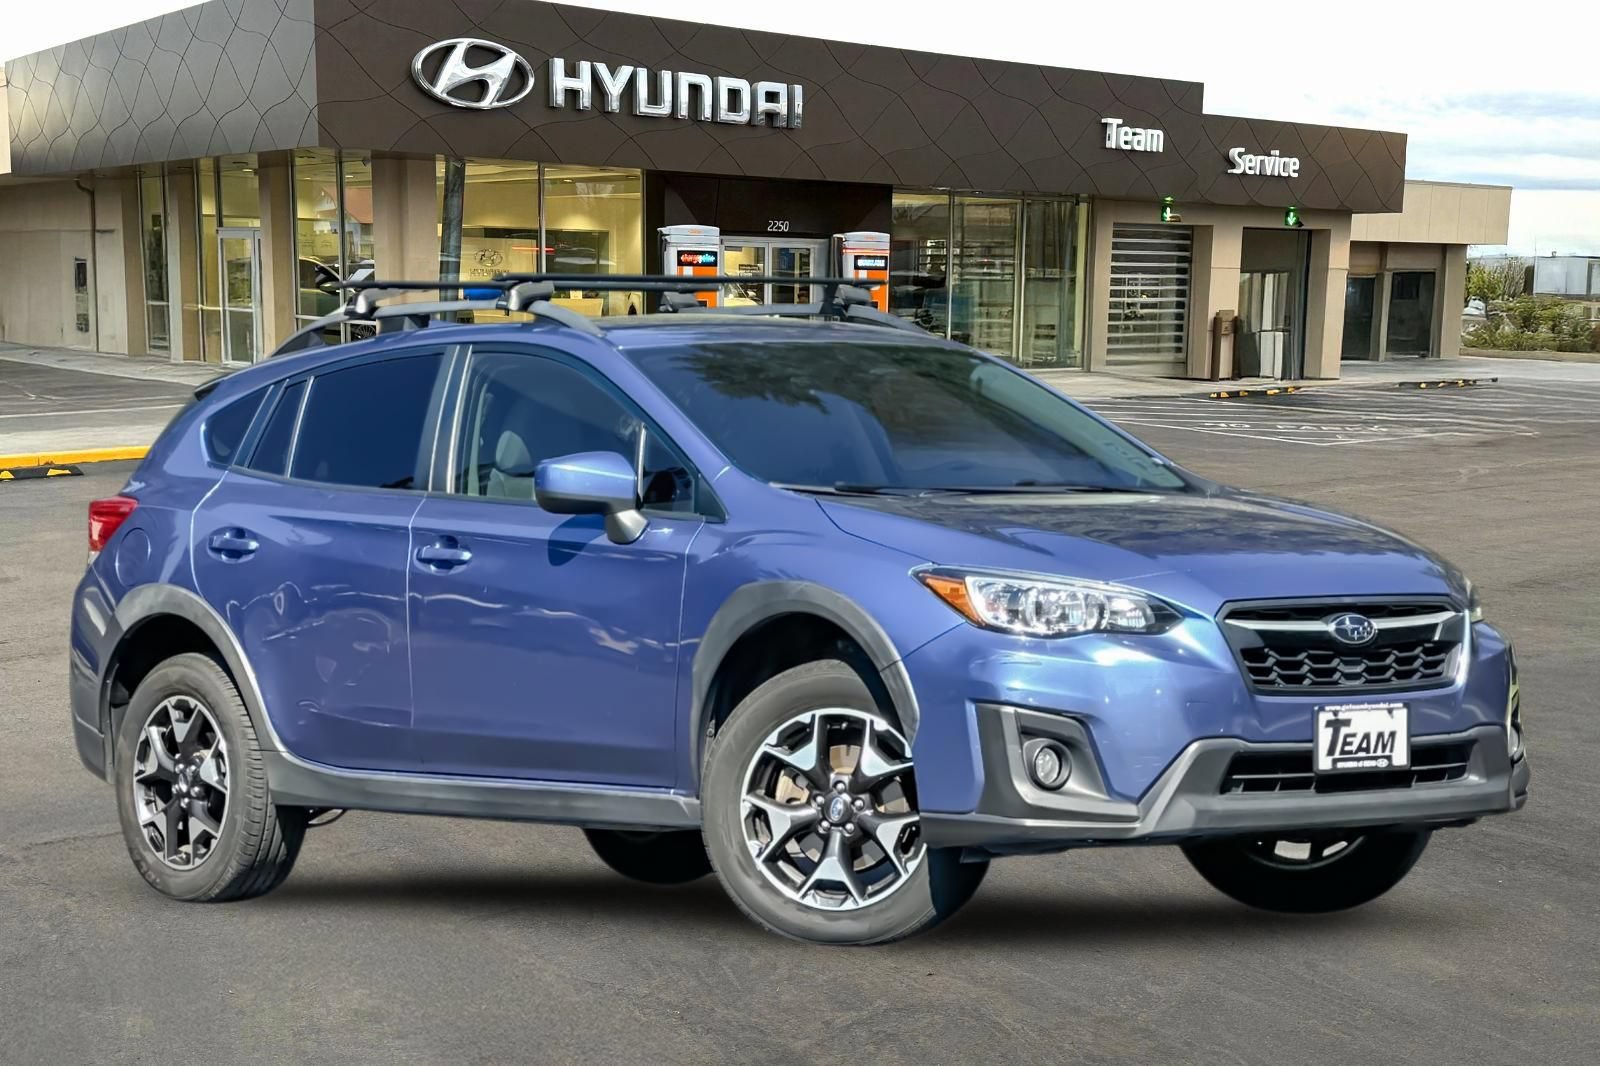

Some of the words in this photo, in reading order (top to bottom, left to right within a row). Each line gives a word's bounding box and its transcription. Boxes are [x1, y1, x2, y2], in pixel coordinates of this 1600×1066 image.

[548, 57, 803, 129] HYUNDAI
[1101, 117, 1164, 152] Team
[1227, 147, 1300, 178] Service
[767, 220, 790, 232] 2250
[1324, 718, 1397, 757] TEAM
